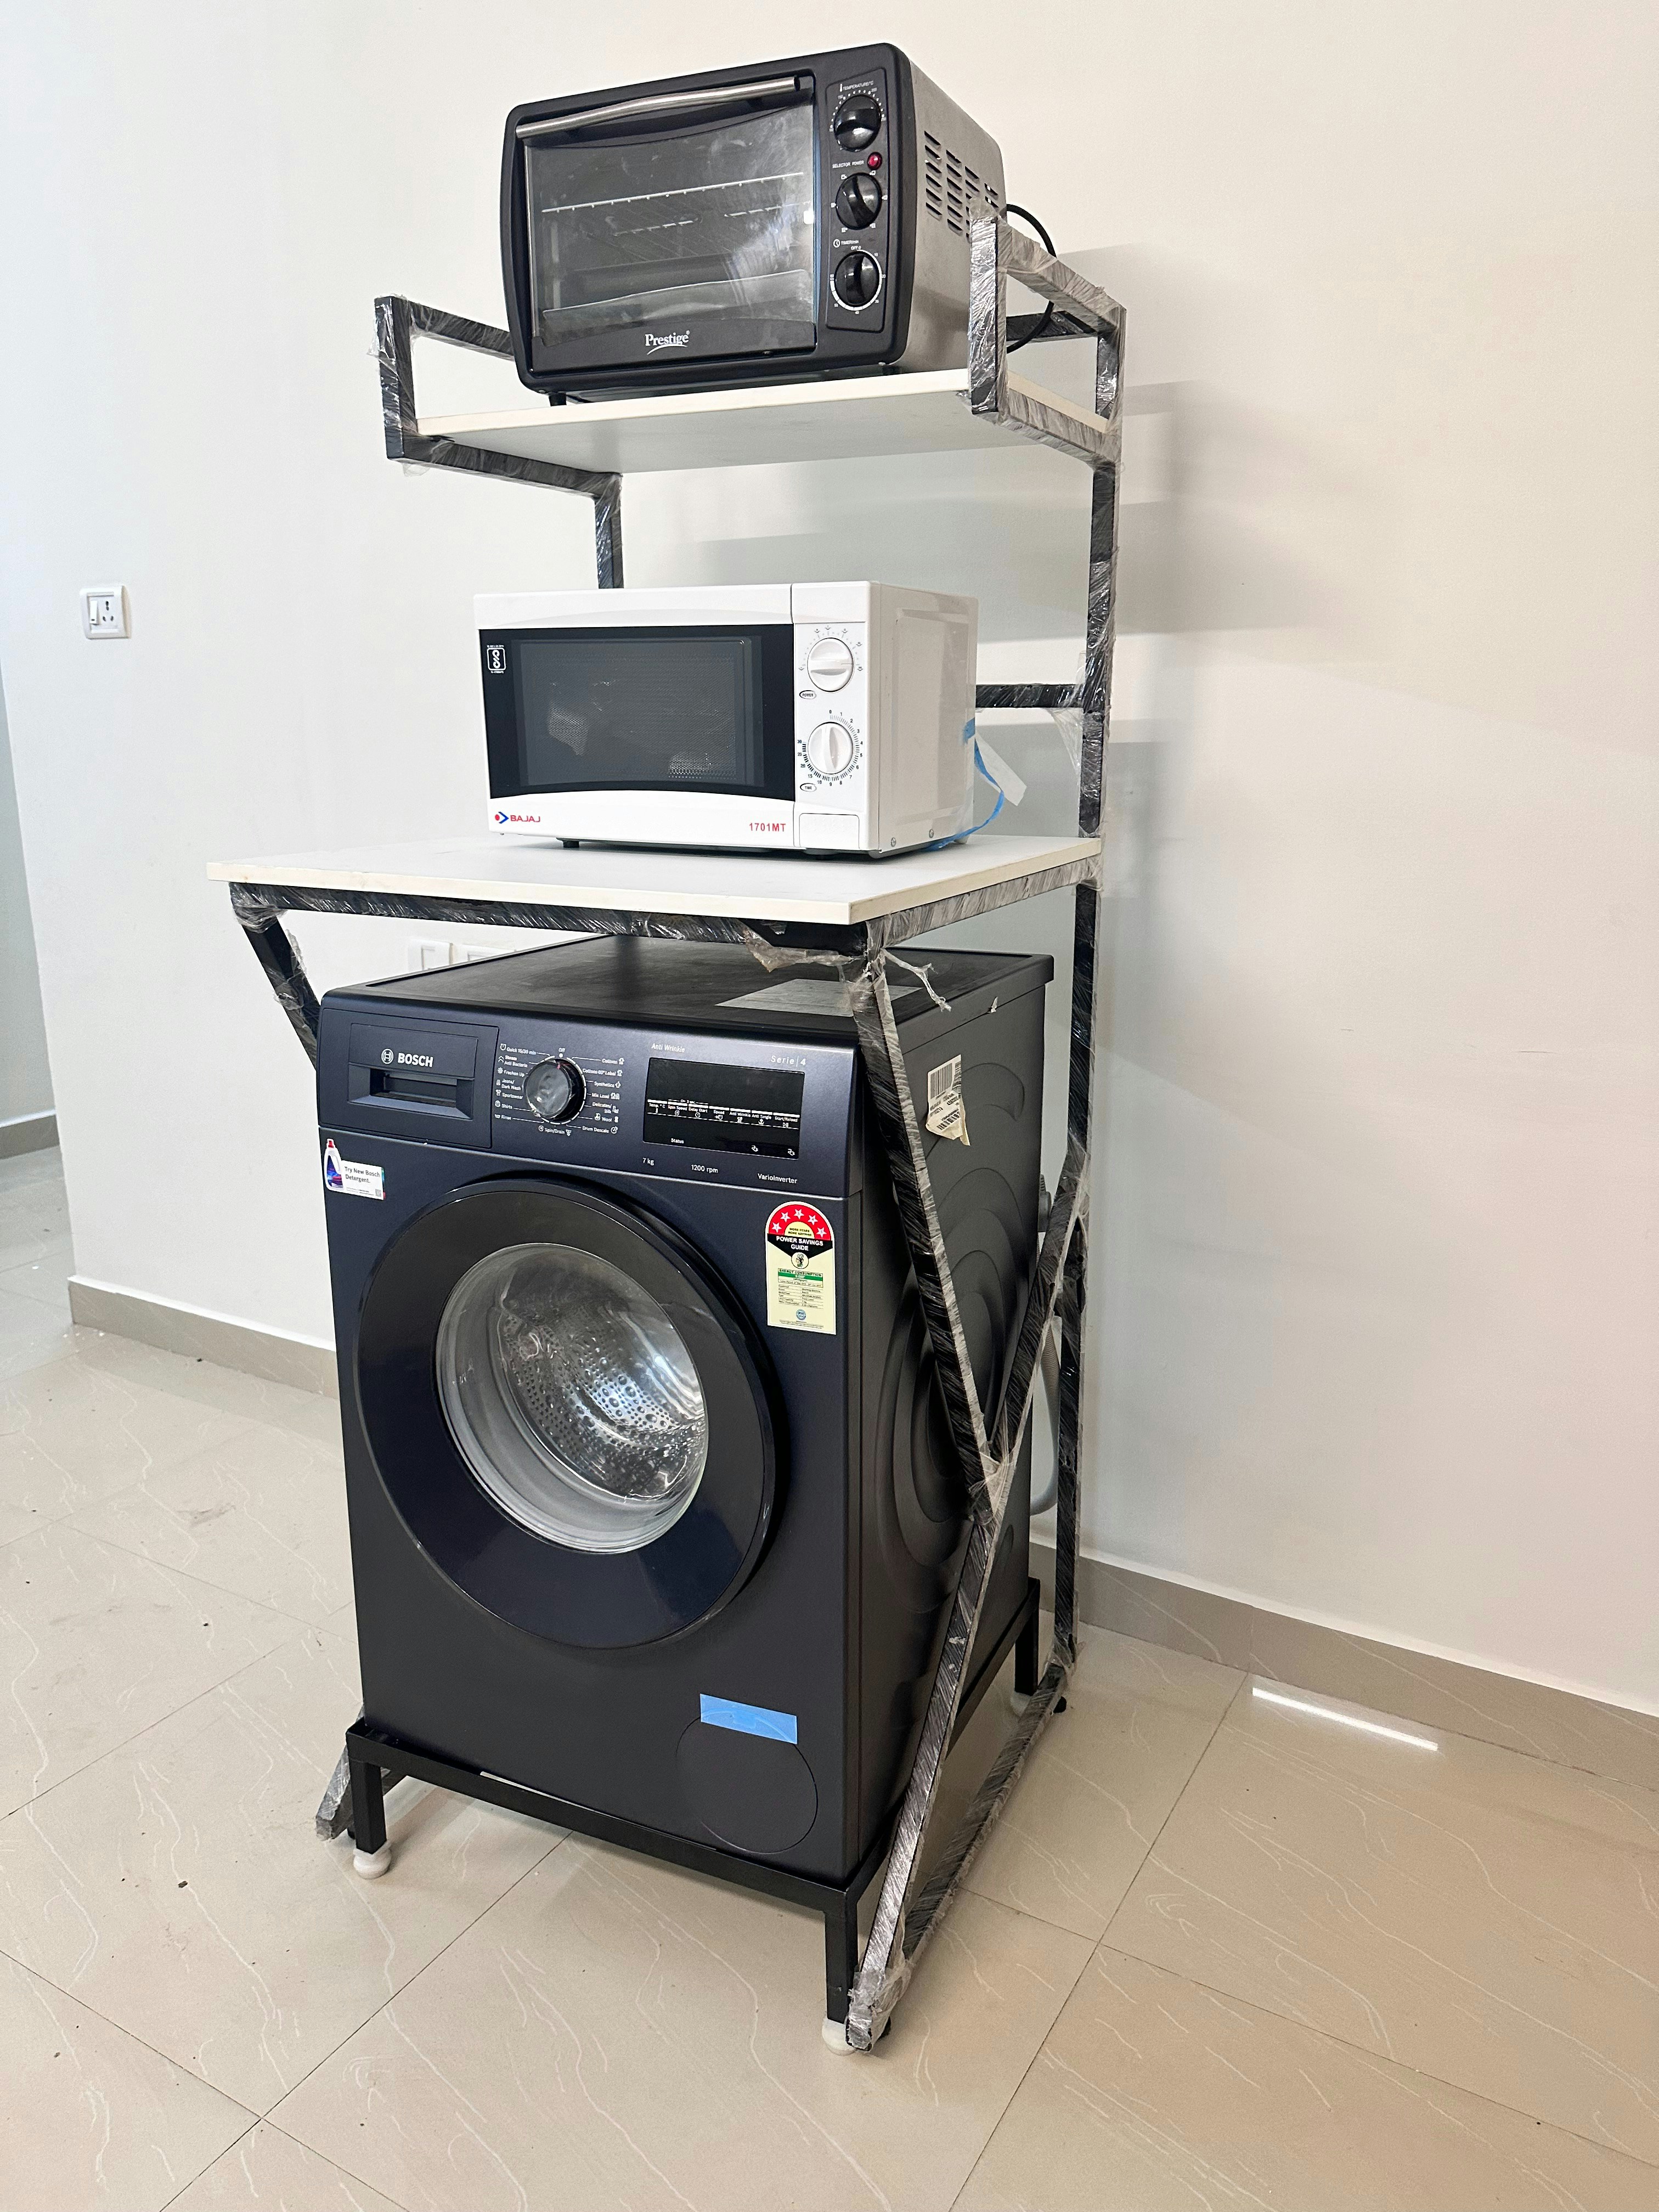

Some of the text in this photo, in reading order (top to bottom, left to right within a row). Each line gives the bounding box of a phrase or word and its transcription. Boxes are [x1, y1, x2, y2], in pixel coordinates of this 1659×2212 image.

[645, 332, 689, 346] Prestige
[749, 823, 786, 832] 1701MT
[664, 1044, 685, 1053] Wrinkle
[397, 1052, 433, 1068] BOSCH
[757, 1173, 798, 1184] VarioInverter
[798, 1238, 823, 1246] SAVINGS
